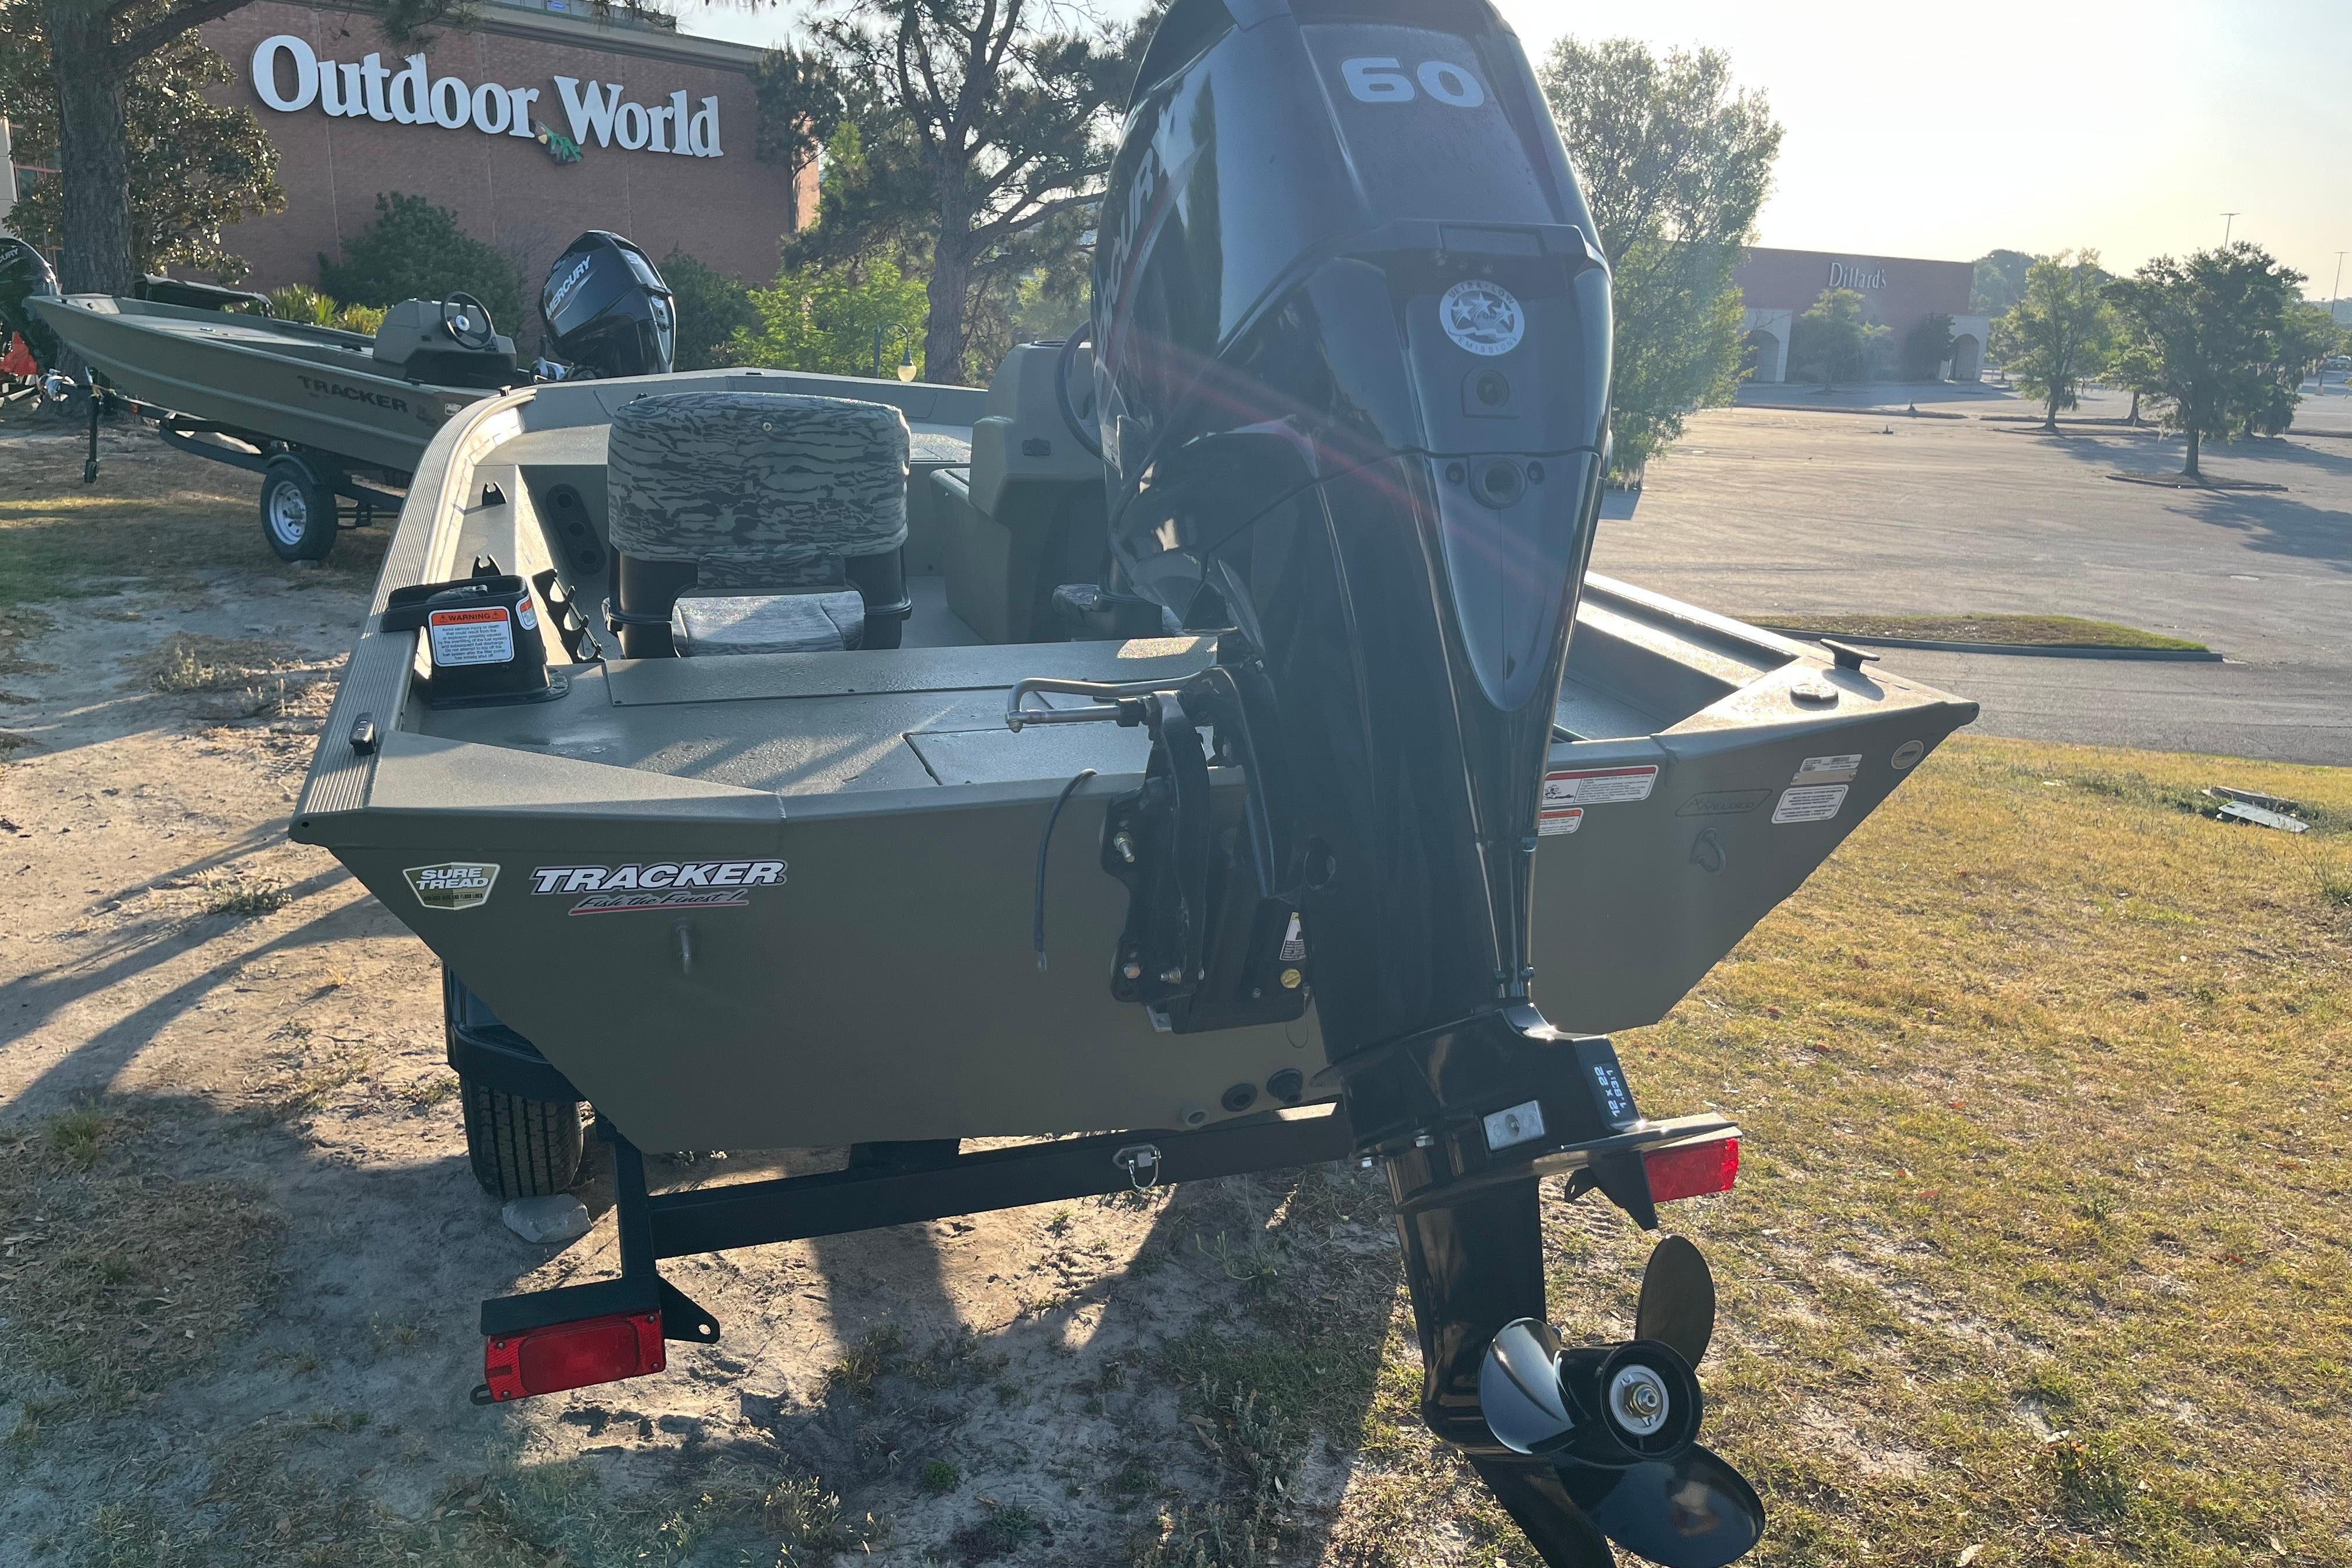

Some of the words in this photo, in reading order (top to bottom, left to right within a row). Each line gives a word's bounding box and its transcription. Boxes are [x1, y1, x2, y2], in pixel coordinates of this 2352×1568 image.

[1341, 57, 1485, 107] 60
[251, 34, 540, 139] Outdoor
[554, 75, 724, 158] World
[1829, 262, 1887, 289] Dillard's
[546, 255, 590, 321] MERCURY
[298, 375, 408, 412] TRACKER
[448, 613, 491, 621] WARNING
[421, 867, 483, 880] SURE
[416, 877, 489, 890] TREAD
[579, 897, 624, 908] Fish
[630, 893, 657, 906] the
[1594, 1066, 1609, 1086] 22
[1605, 1088, 1614, 1097] x
[1608, 1100, 1620, 1117] 12
